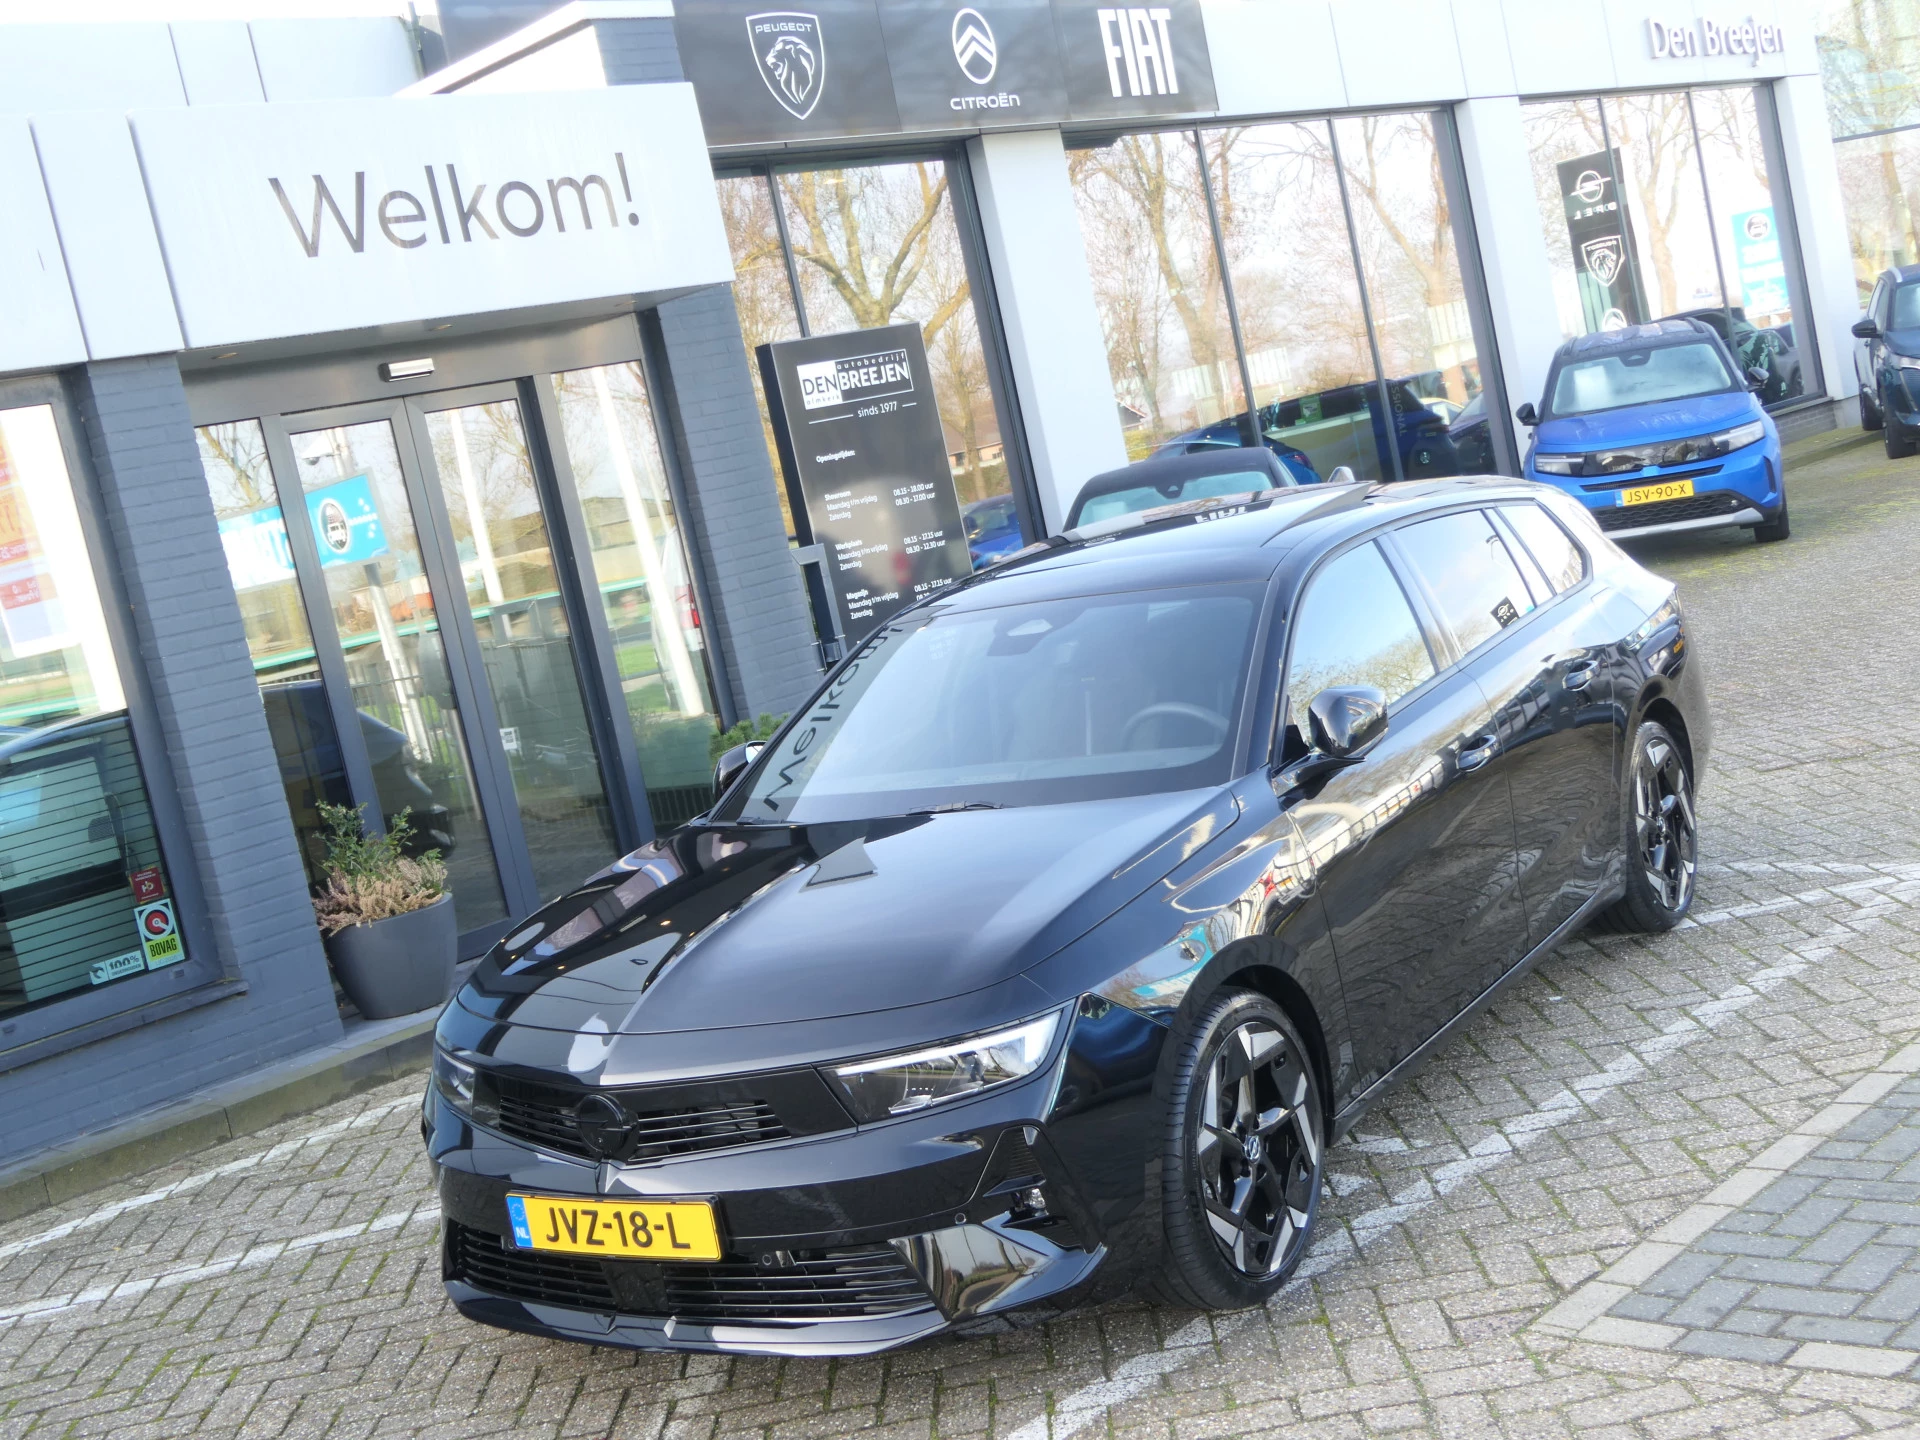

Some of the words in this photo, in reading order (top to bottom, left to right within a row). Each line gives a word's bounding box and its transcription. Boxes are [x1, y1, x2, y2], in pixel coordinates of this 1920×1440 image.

[755, 22, 813, 34] PEUGEOT
[1644, 16, 1698, 59] Den
[1697, 14, 1786, 67] Breejen
[1097, 8, 1180, 98] FIAT
[267, 151, 641, 258] Welkom!
[837, 351, 905, 370] autobedrijf
[802, 374, 839, 396] DEN
[838, 361, 910, 391] BREEJEN
[806, 395, 841, 406] almkerk
[858, 404, 879, 418] sinds
[880, 401, 898, 414] 1977
[825, 490, 851, 501] Showroom
[827, 500, 851, 511] Maandag
[860, 495, 878, 505] vrijdag
[925, 482, 934, 490] uur
[1627, 483, 1686, 503] JSV-90-X
[829, 511, 851, 522] Zaterdag
[835, 539, 863, 551] Werkplaats
[837, 549, 861, 561] Maandag
[870, 543, 888, 554] vrijdag
[934, 530, 943, 538] uur
[839, 560, 862, 571] Zaterdag
[936, 539, 946, 547] uur
[846, 588, 869, 600] Magazijn
[848, 598, 872, 610] Maandag
[881, 591, 899, 602] vrijdag
[943, 577, 953, 585] uur
[850, 608, 873, 620] Zaterdag
[149, 937, 178, 957] BOVAG
[108, 954, 139, 970] 100%
[516, 1227, 529, 1239] NL
[546, 1207, 691, 1250] JVZ-18-L
